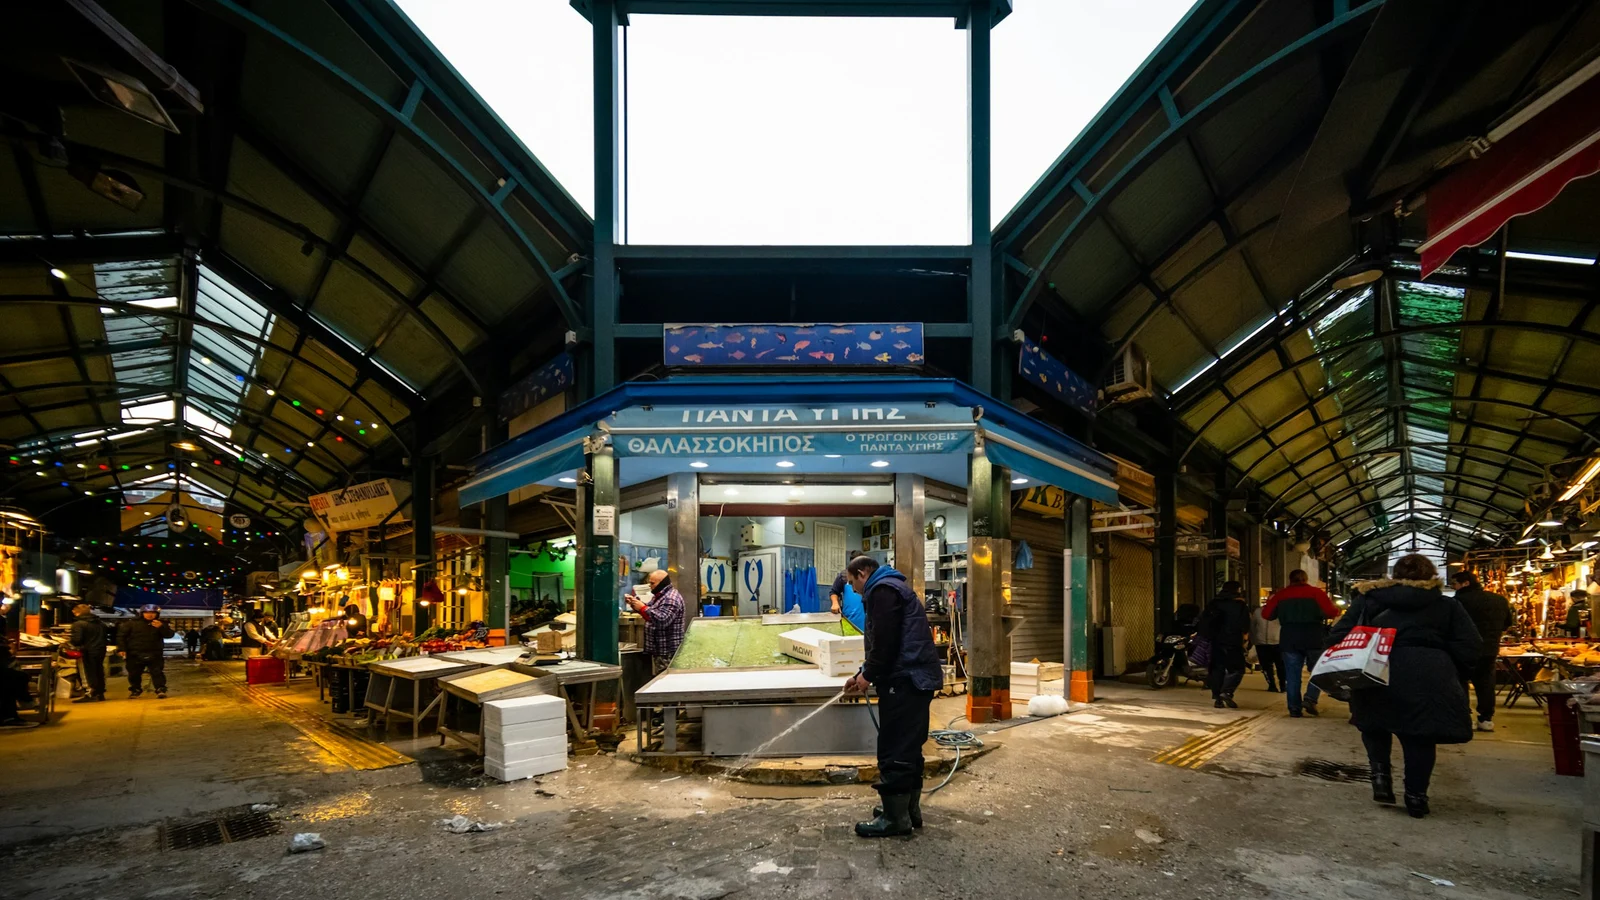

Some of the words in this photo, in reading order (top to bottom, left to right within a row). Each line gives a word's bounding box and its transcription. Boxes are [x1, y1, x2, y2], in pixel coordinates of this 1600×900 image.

[845, 433, 856, 442] Ο
[859, 433, 912, 442] ΤΡΩΓΩΝ
[916, 432, 958, 441] ΙΧΘΕΙΣ
[627, 435, 815, 454] ΘΑΛΑΣΣΟΚΗΠΟΣ
[860, 443, 904, 452] ΠΑΝΤΑ
[907, 442, 944, 451] ΥΓΙΗΣ
[792, 645, 813, 657] MOWI
